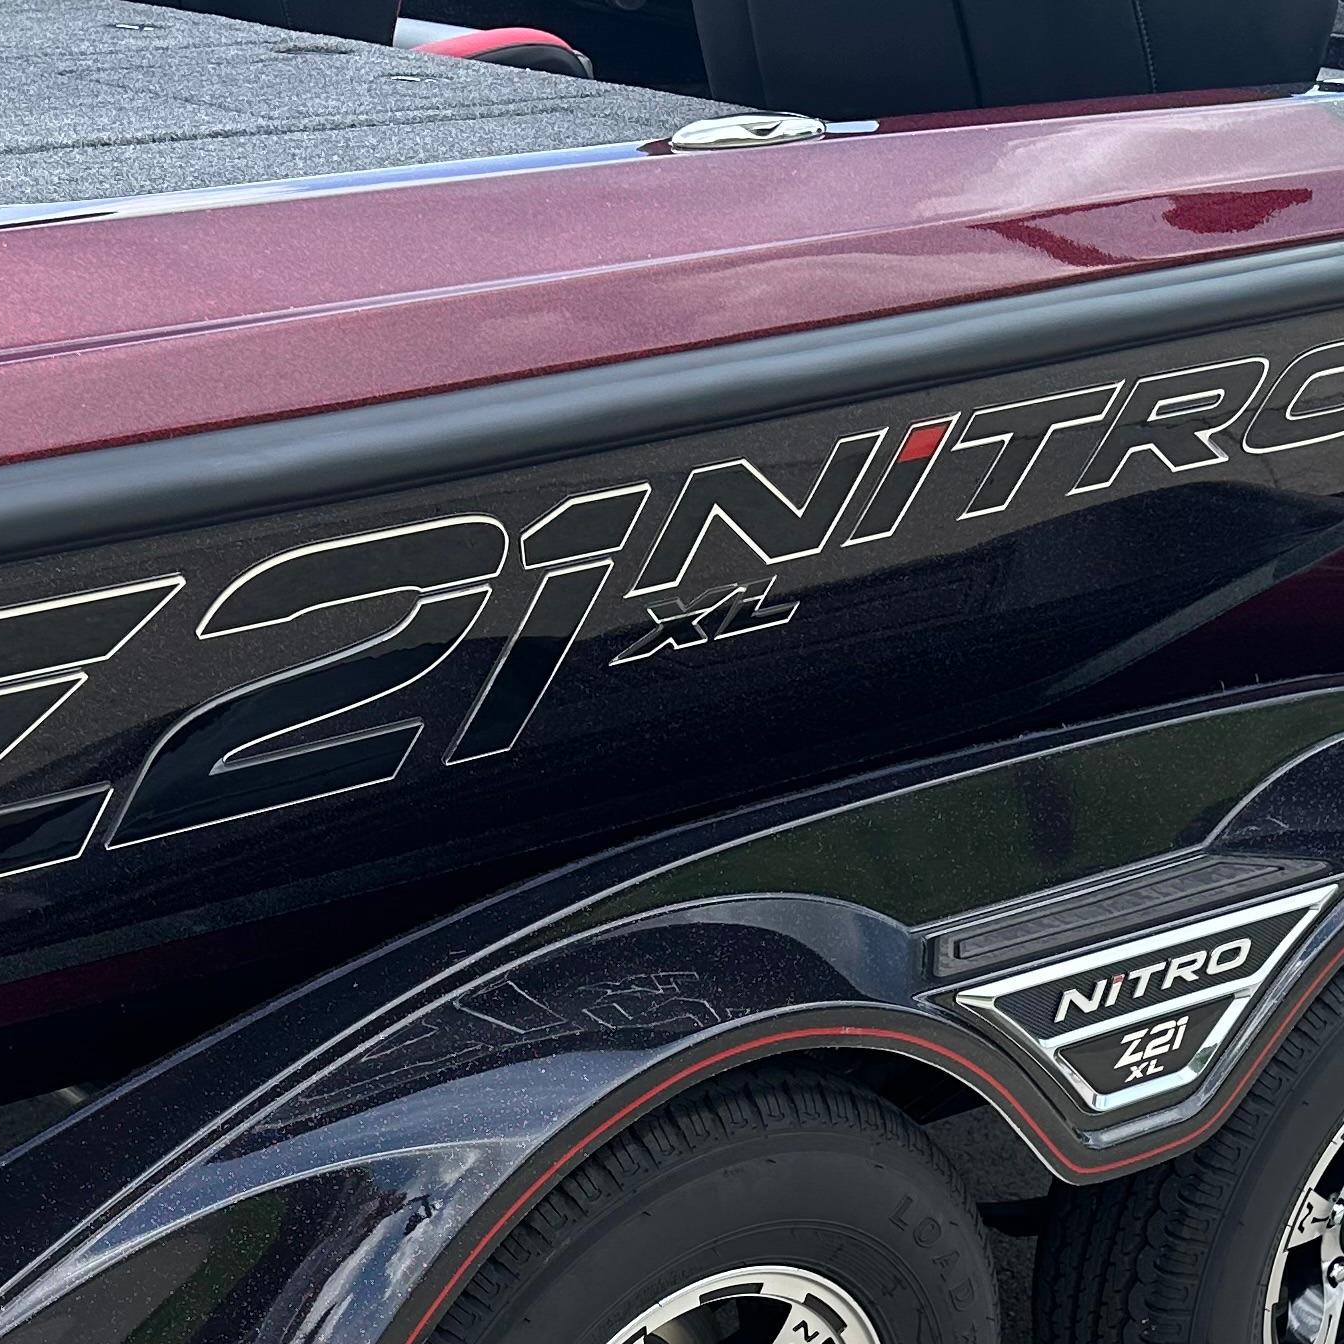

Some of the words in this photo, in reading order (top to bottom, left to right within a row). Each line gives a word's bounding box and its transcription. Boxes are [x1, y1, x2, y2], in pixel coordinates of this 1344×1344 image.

[608, 574, 801, 667] XL
[1053, 937, 1252, 1024] NITRO
[1113, 1015, 1190, 1070] Z21
[1124, 1059, 1165, 1083] XL
[889, 1196, 975, 1313] LOAD
